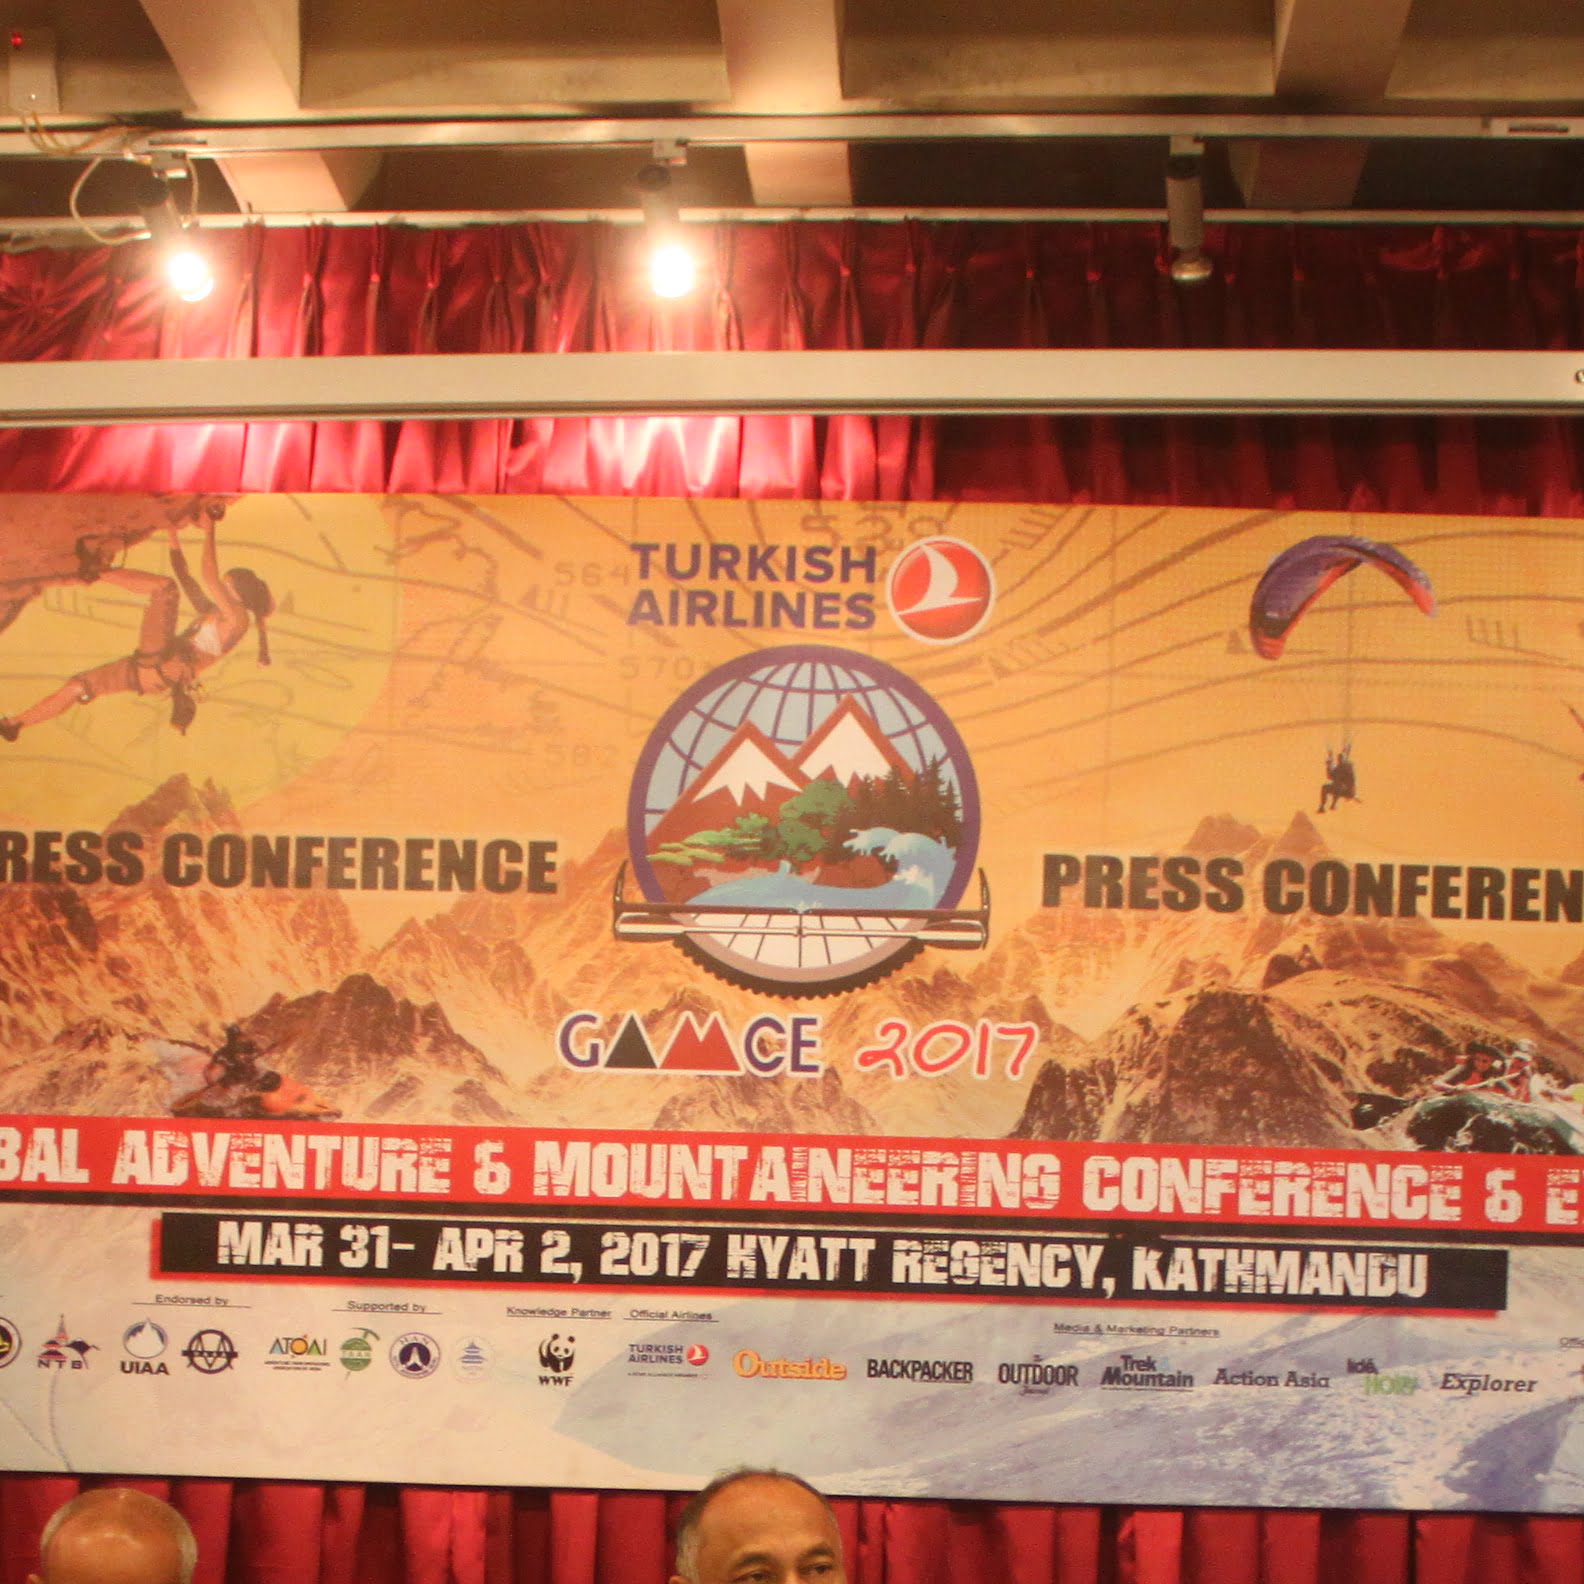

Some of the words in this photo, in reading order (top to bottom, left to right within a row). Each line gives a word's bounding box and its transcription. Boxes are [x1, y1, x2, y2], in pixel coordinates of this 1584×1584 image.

[630, 543, 877, 583] TURKISH
[627, 589, 877, 629] AIRLINES
[161, 832, 558, 893] CONFERENCE
[1042, 853, 1245, 913] PRESS
[857, 1022, 1036, 1076] 2017
[113, 1130, 451, 1194] ADVENTURE
[1082, 1156, 1463, 1222] CONFERENCE
[218, 1221, 325, 1268] MAR
[433, 1228, 523, 1273] APR
[540, 1230, 583, 1284] 2,
[600, 1232, 711, 1278] 2017
[727, 1236, 876, 1282] HYATT
[892, 1239, 1116, 1298] REGENCY,
[1132, 1246, 1429, 1299] KATHMANDU
[156, 1294, 210, 1305] Endorsed
[215, 1295, 229, 1306] by
[348, 1301, 408, 1313] Supported
[413, 1304, 426, 1313] by
[507, 1307, 567, 1317] Knowledge
[571, 1308, 611, 1318] Partner
[630, 1310, 667, 1320] Official
[673, 1311, 712, 1320] Airlines
[1054, 1323, 1089, 1332] Media
[629, 1344, 683, 1353] TURKISH
[38, 1359, 84, 1369] NTB
[121, 1361, 169, 1375] UIAA
[628, 1354, 683, 1364] AIRLINES
[733, 1349, 847, 1380] Outside
[1121, 1355, 1156, 1371] Trek
[867, 1358, 973, 1381] BACKPACKER
[998, 1363, 1078, 1386] OUTDOOR
[1101, 1367, 1193, 1387] Mountain
[1214, 1368, 1278, 1387] Action
[1284, 1371, 1329, 1388] Asia
[539, 1375, 575, 1386] WWF
[1440, 1373, 1538, 1395] Explorer
